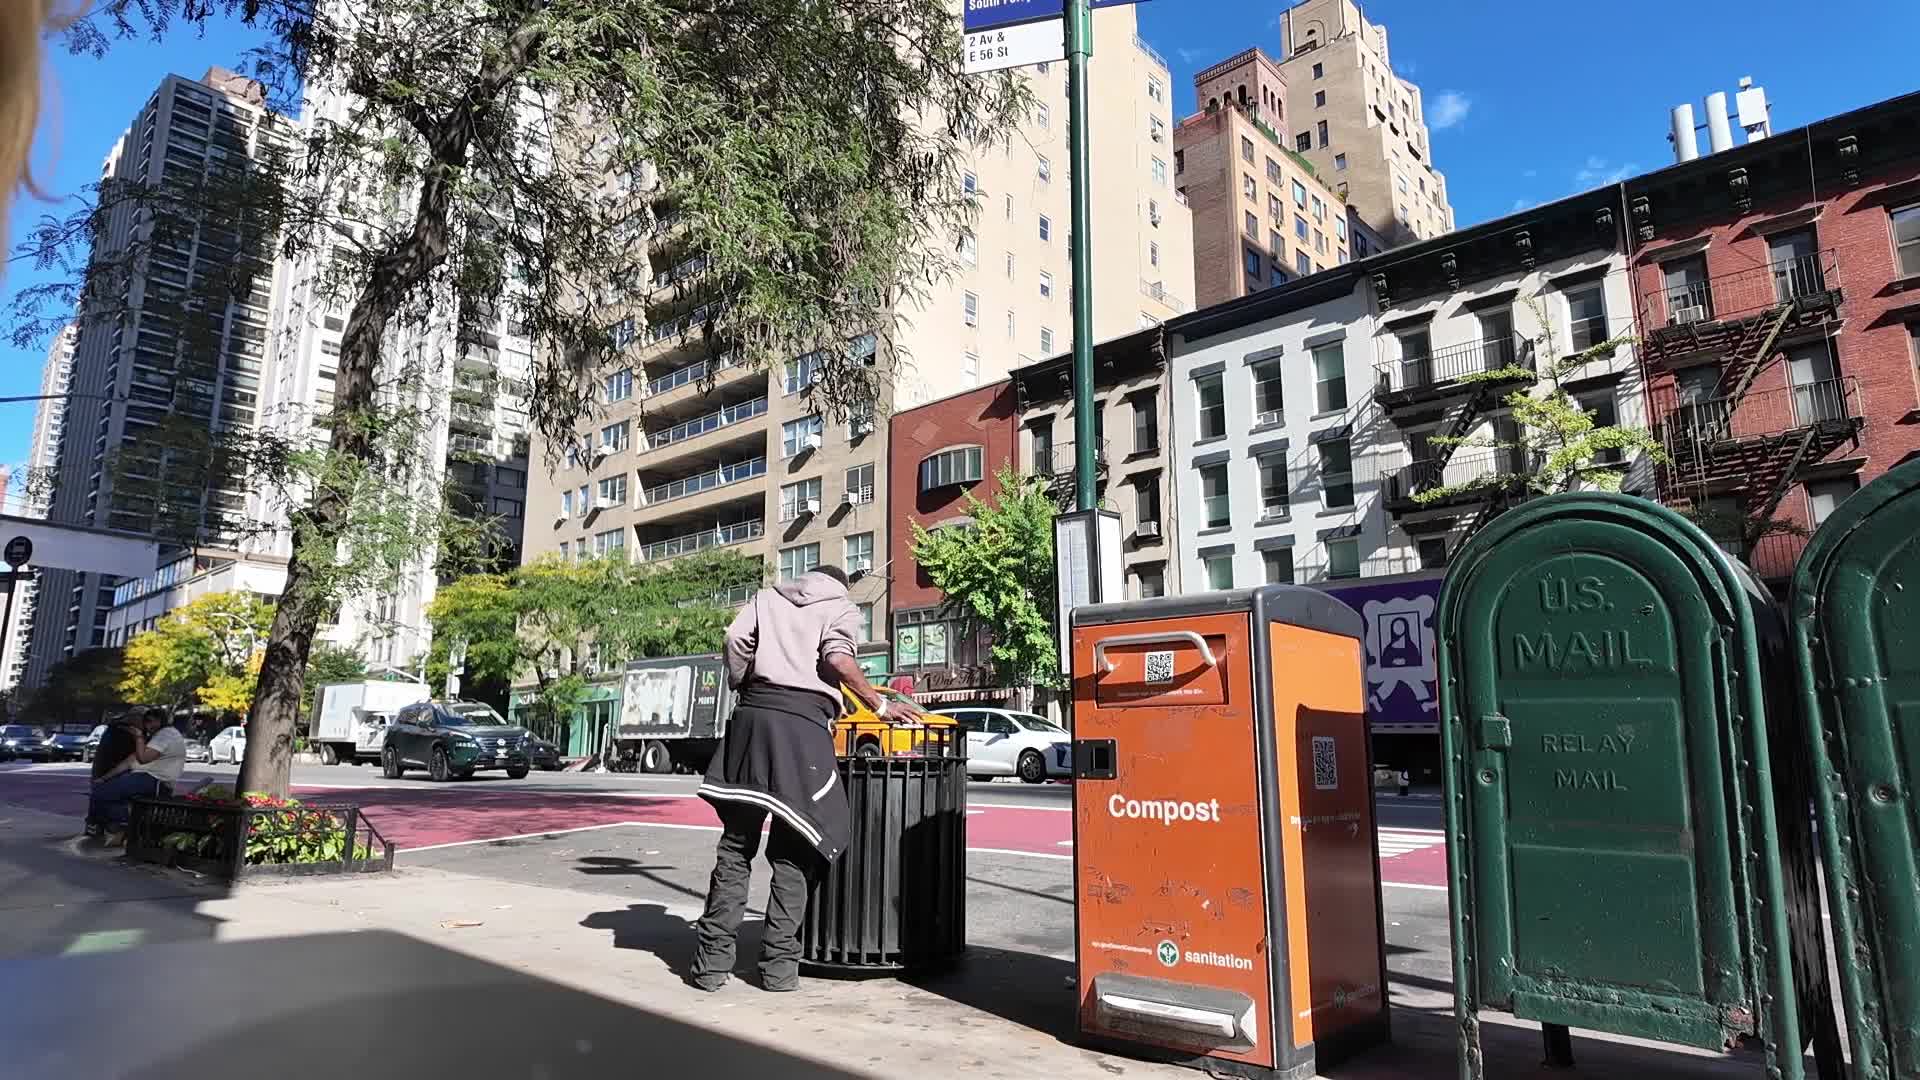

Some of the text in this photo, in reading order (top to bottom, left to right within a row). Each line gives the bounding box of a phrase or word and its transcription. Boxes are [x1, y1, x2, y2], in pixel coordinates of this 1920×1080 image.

[969, 32, 1005, 47] 2 Av &
[969, 47, 1008, 62] E 56 St
[1539, 576, 1615, 613] U.S.
[1512, 630, 1653, 671] MAIL
[1542, 734, 1635, 753] RELAY
[1554, 769, 1628, 791] MAIL
[1108, 793, 1220, 826] Compost
[1184, 950, 1253, 971] sanitation
